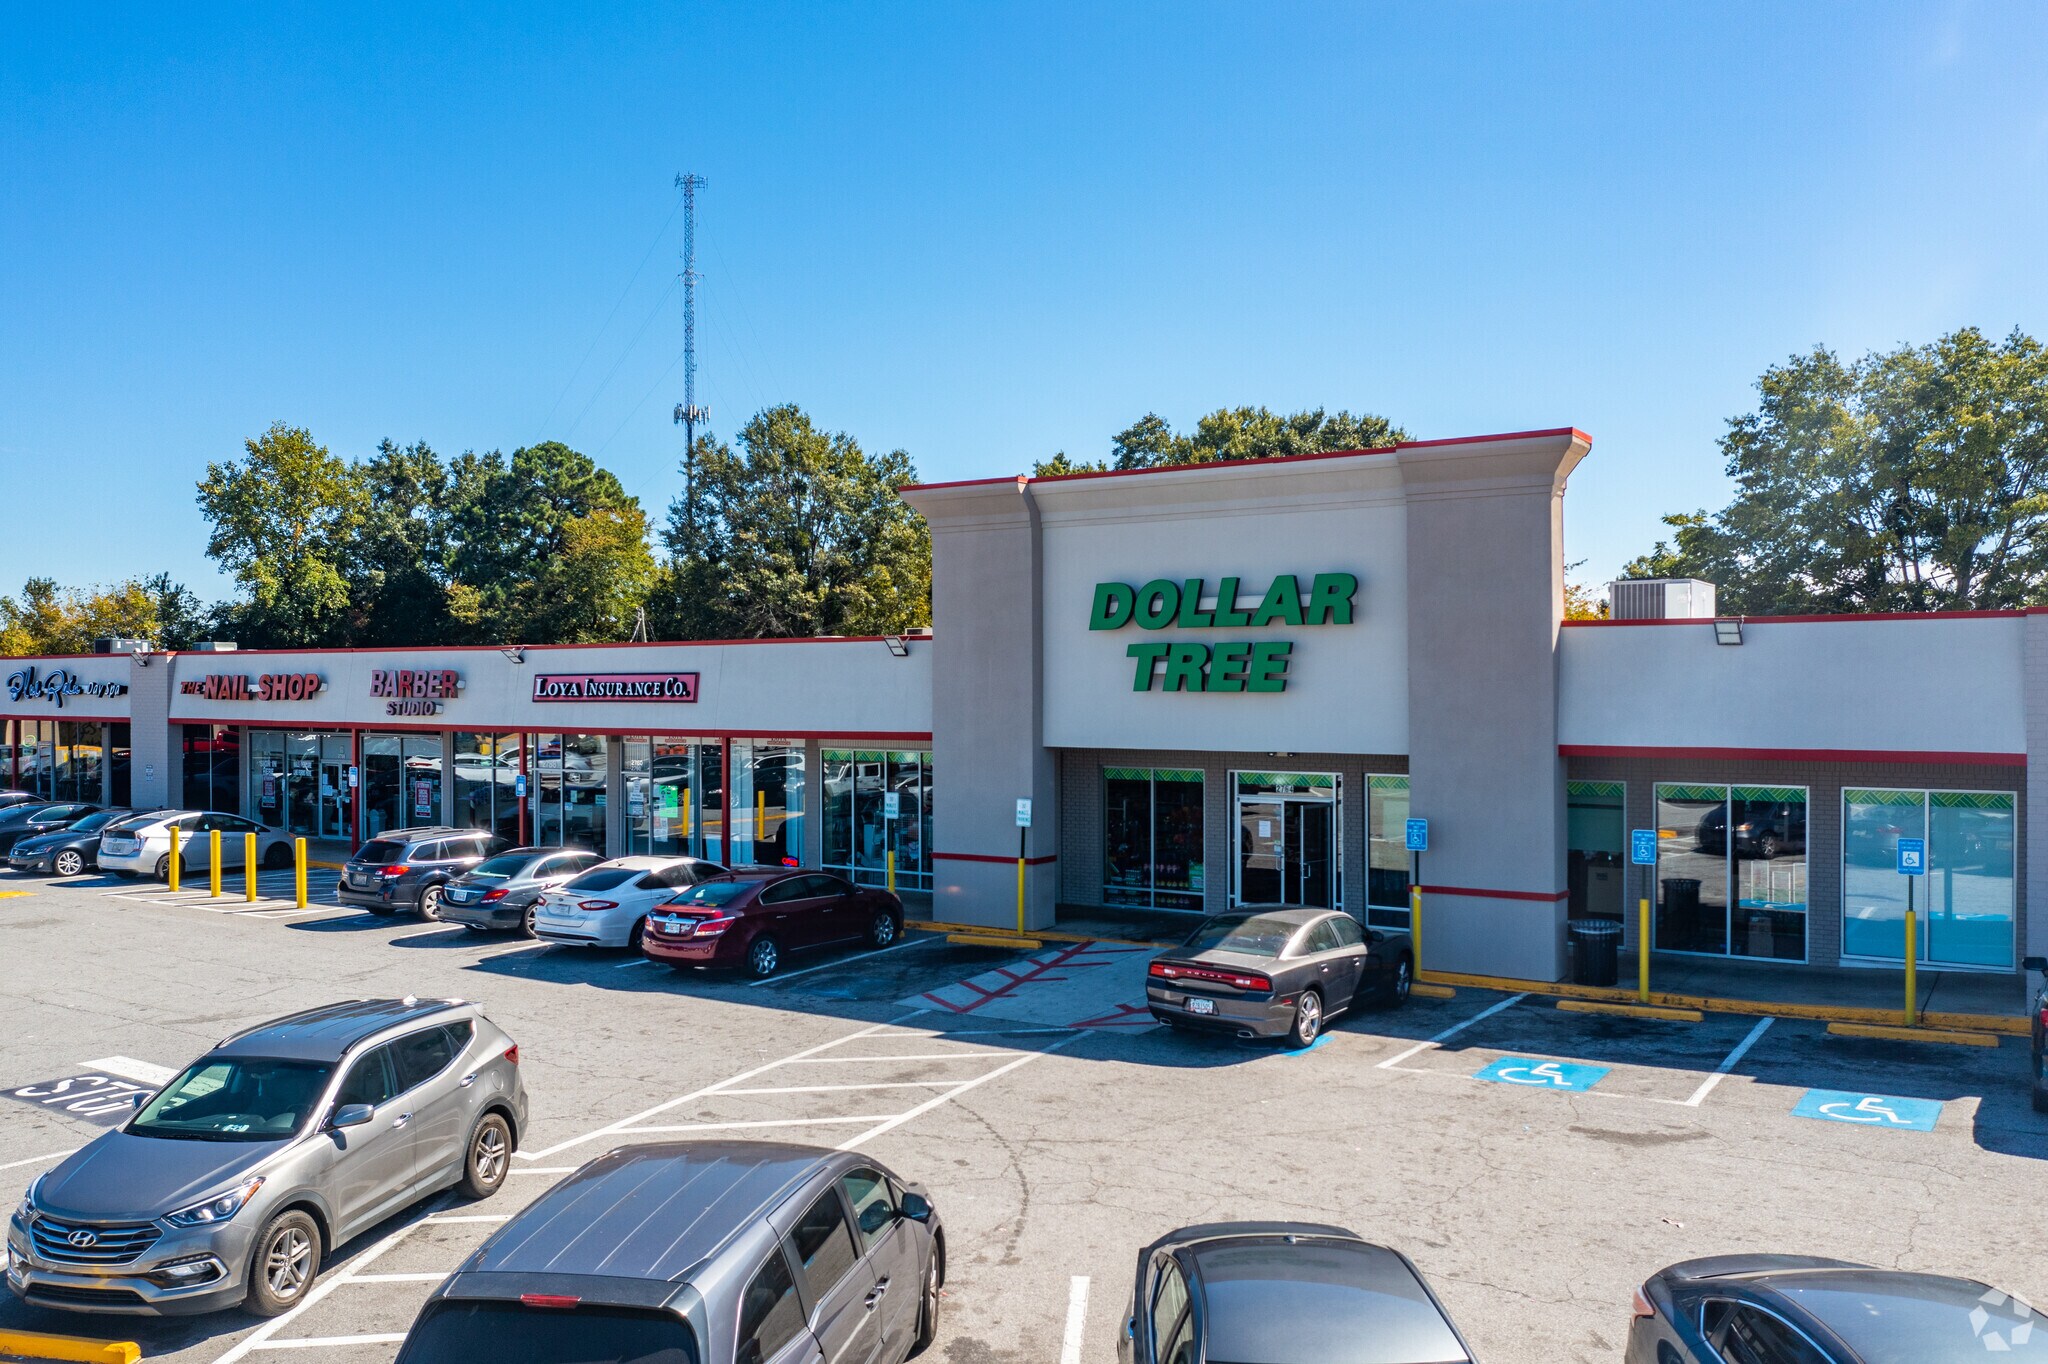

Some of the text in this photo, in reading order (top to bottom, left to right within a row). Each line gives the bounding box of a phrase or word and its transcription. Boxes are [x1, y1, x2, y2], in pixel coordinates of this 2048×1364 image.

[1089, 573, 1358, 630] DOLLAR
[1126, 642, 1293, 692] TREE
[87, 682, 105, 698] Day
[105, 682, 121, 698] Spa
[181, 673, 320, 701] THE NAIL SHOP
[370, 670, 459, 698] BARBER
[535, 678, 580, 697] LOYA
[583, 678, 661, 697] INSURANCE
[386, 700, 436, 715] STUDIO
